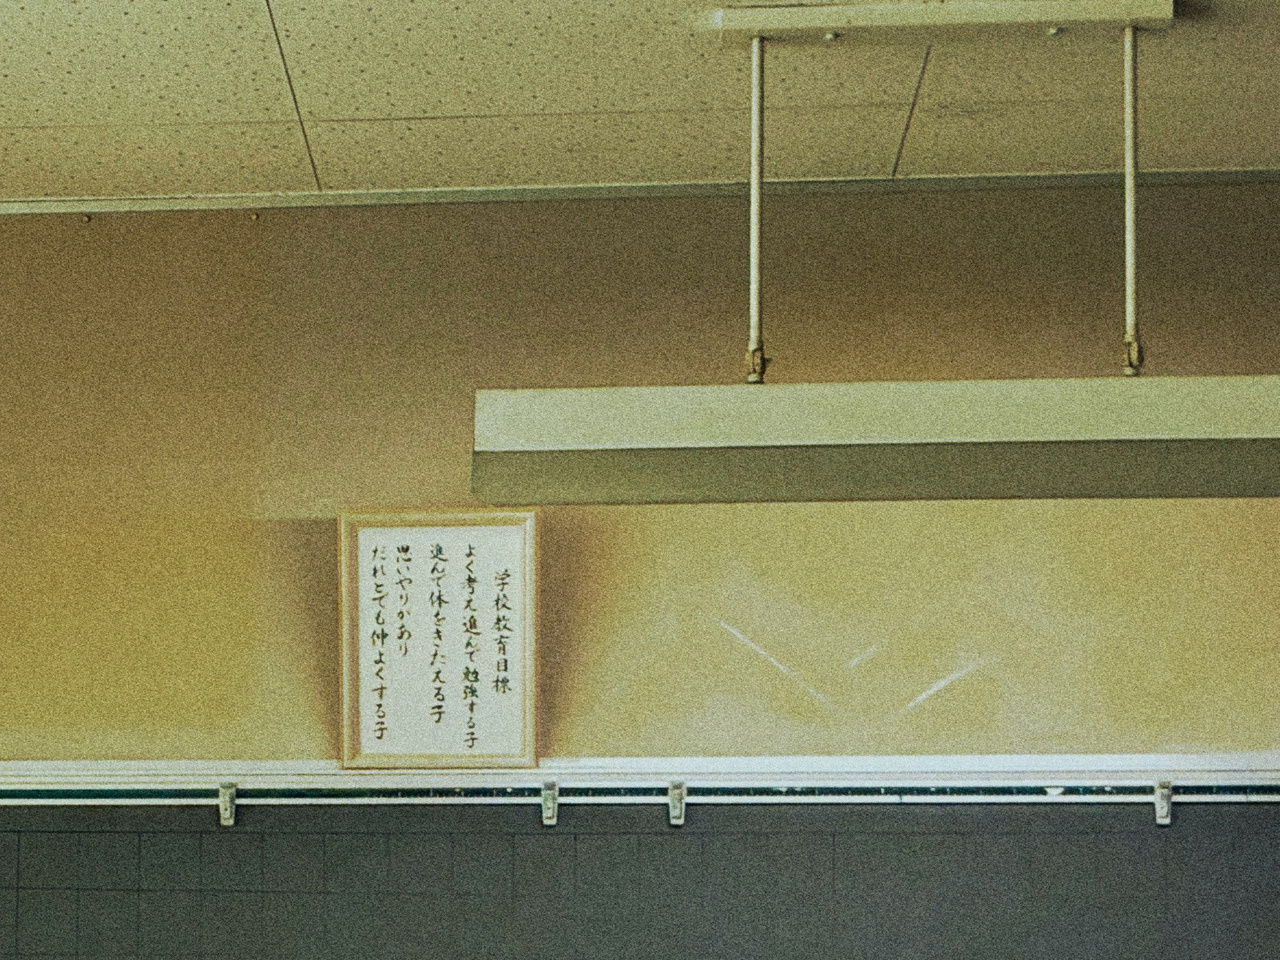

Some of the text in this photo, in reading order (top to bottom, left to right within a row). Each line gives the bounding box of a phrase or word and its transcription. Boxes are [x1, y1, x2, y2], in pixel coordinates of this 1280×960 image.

[395, 545, 413, 657] 思いやりがあり
[492, 569, 513, 694] 学校教育目標
